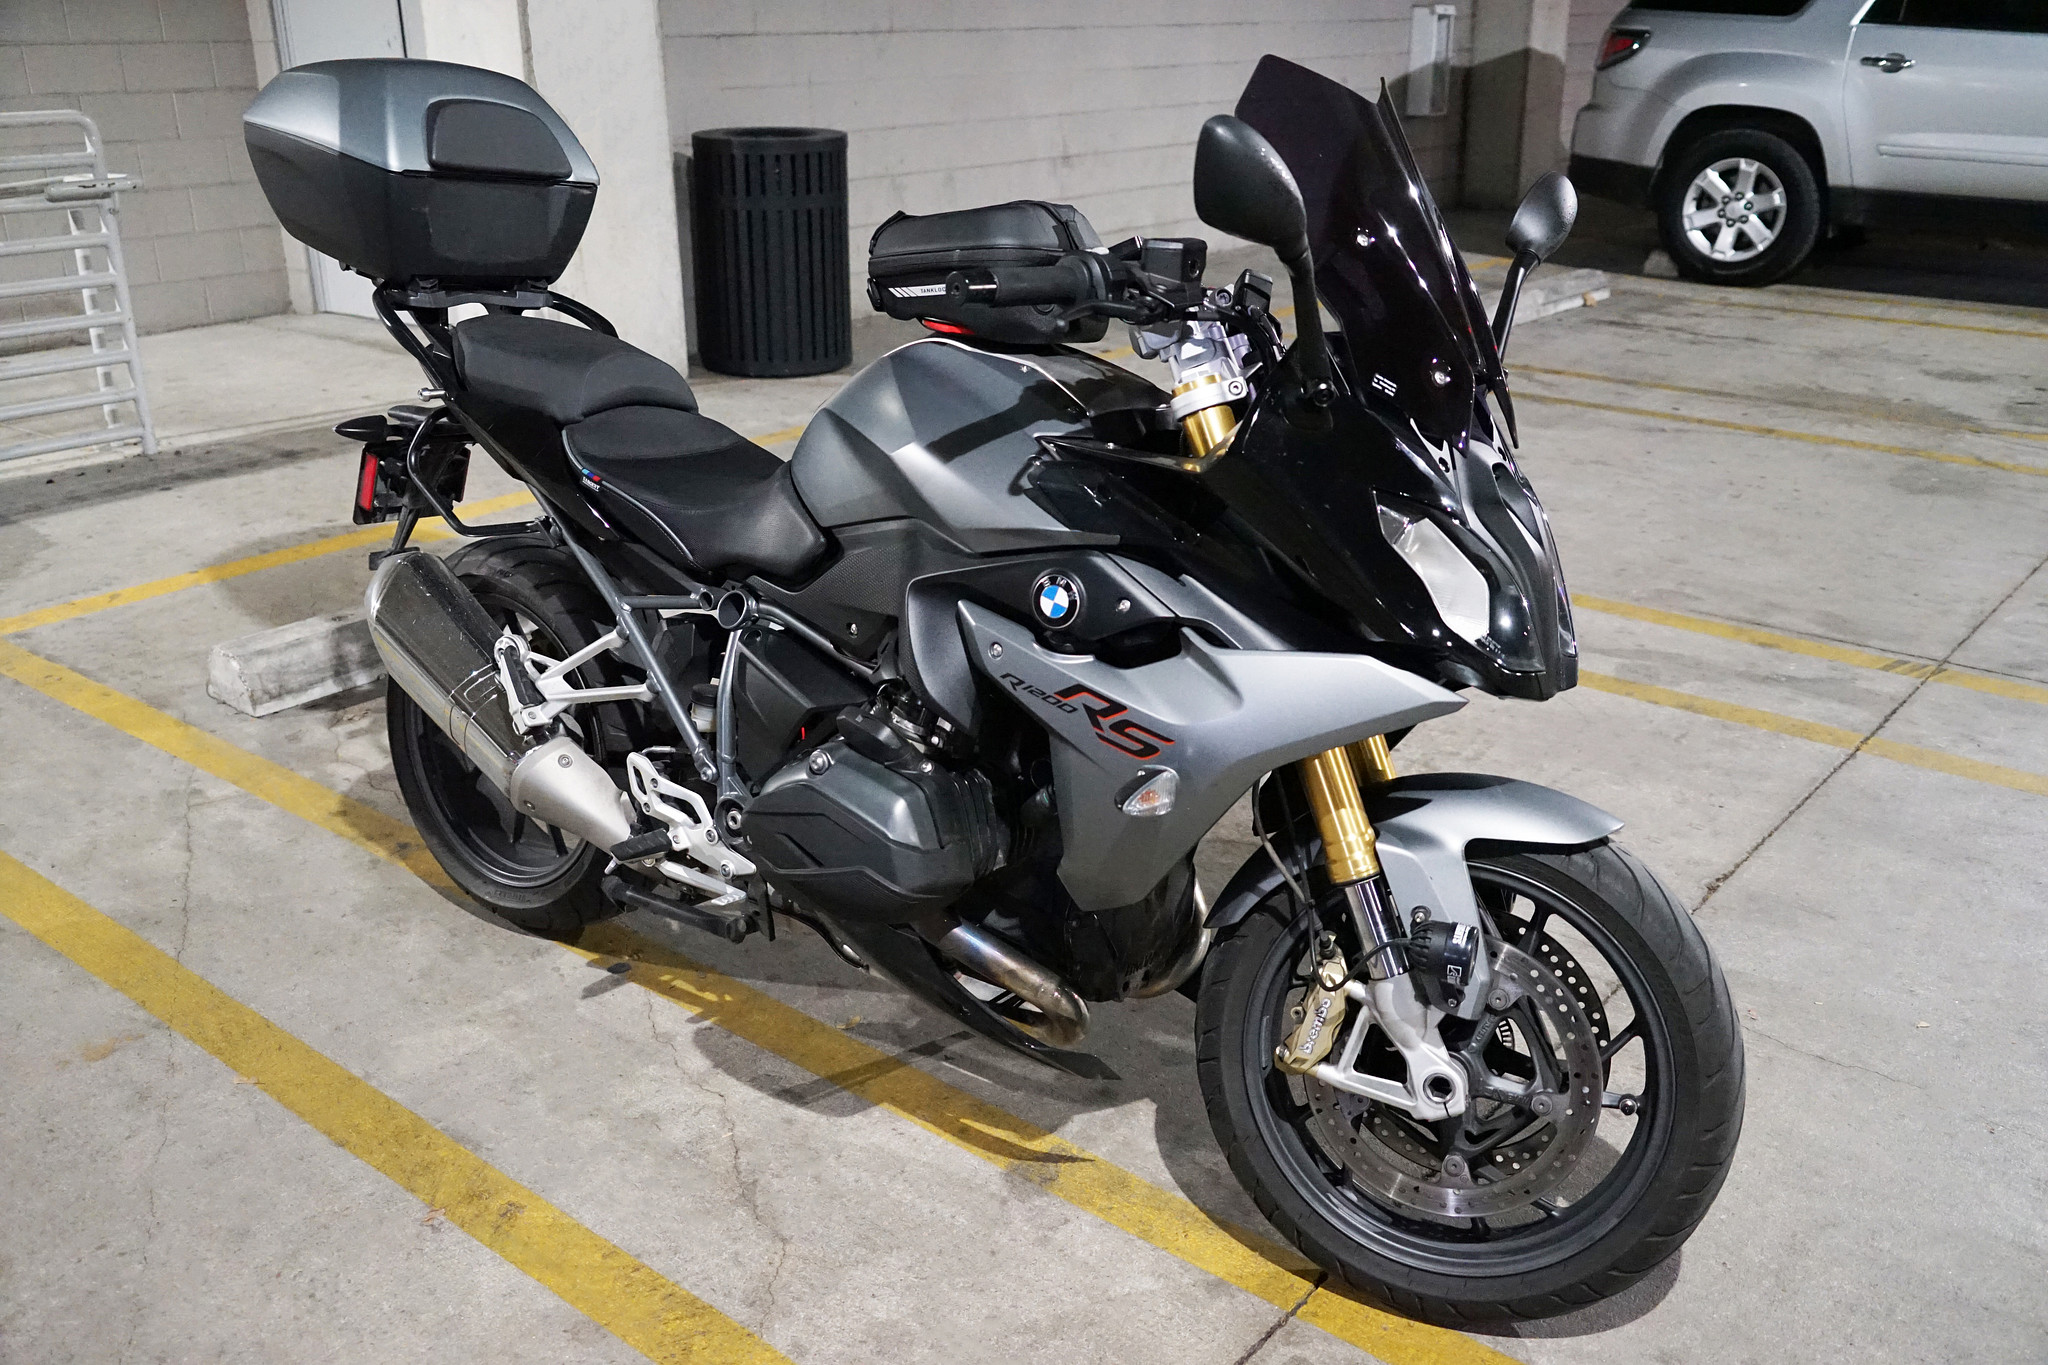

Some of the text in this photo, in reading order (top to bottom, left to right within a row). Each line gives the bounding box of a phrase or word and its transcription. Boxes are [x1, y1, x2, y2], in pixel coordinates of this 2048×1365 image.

[920, 286, 946, 294] TANKLOC
[1000, 672, 1176, 760] R1200 RS
[1299, 998, 1332, 1054] brembo
